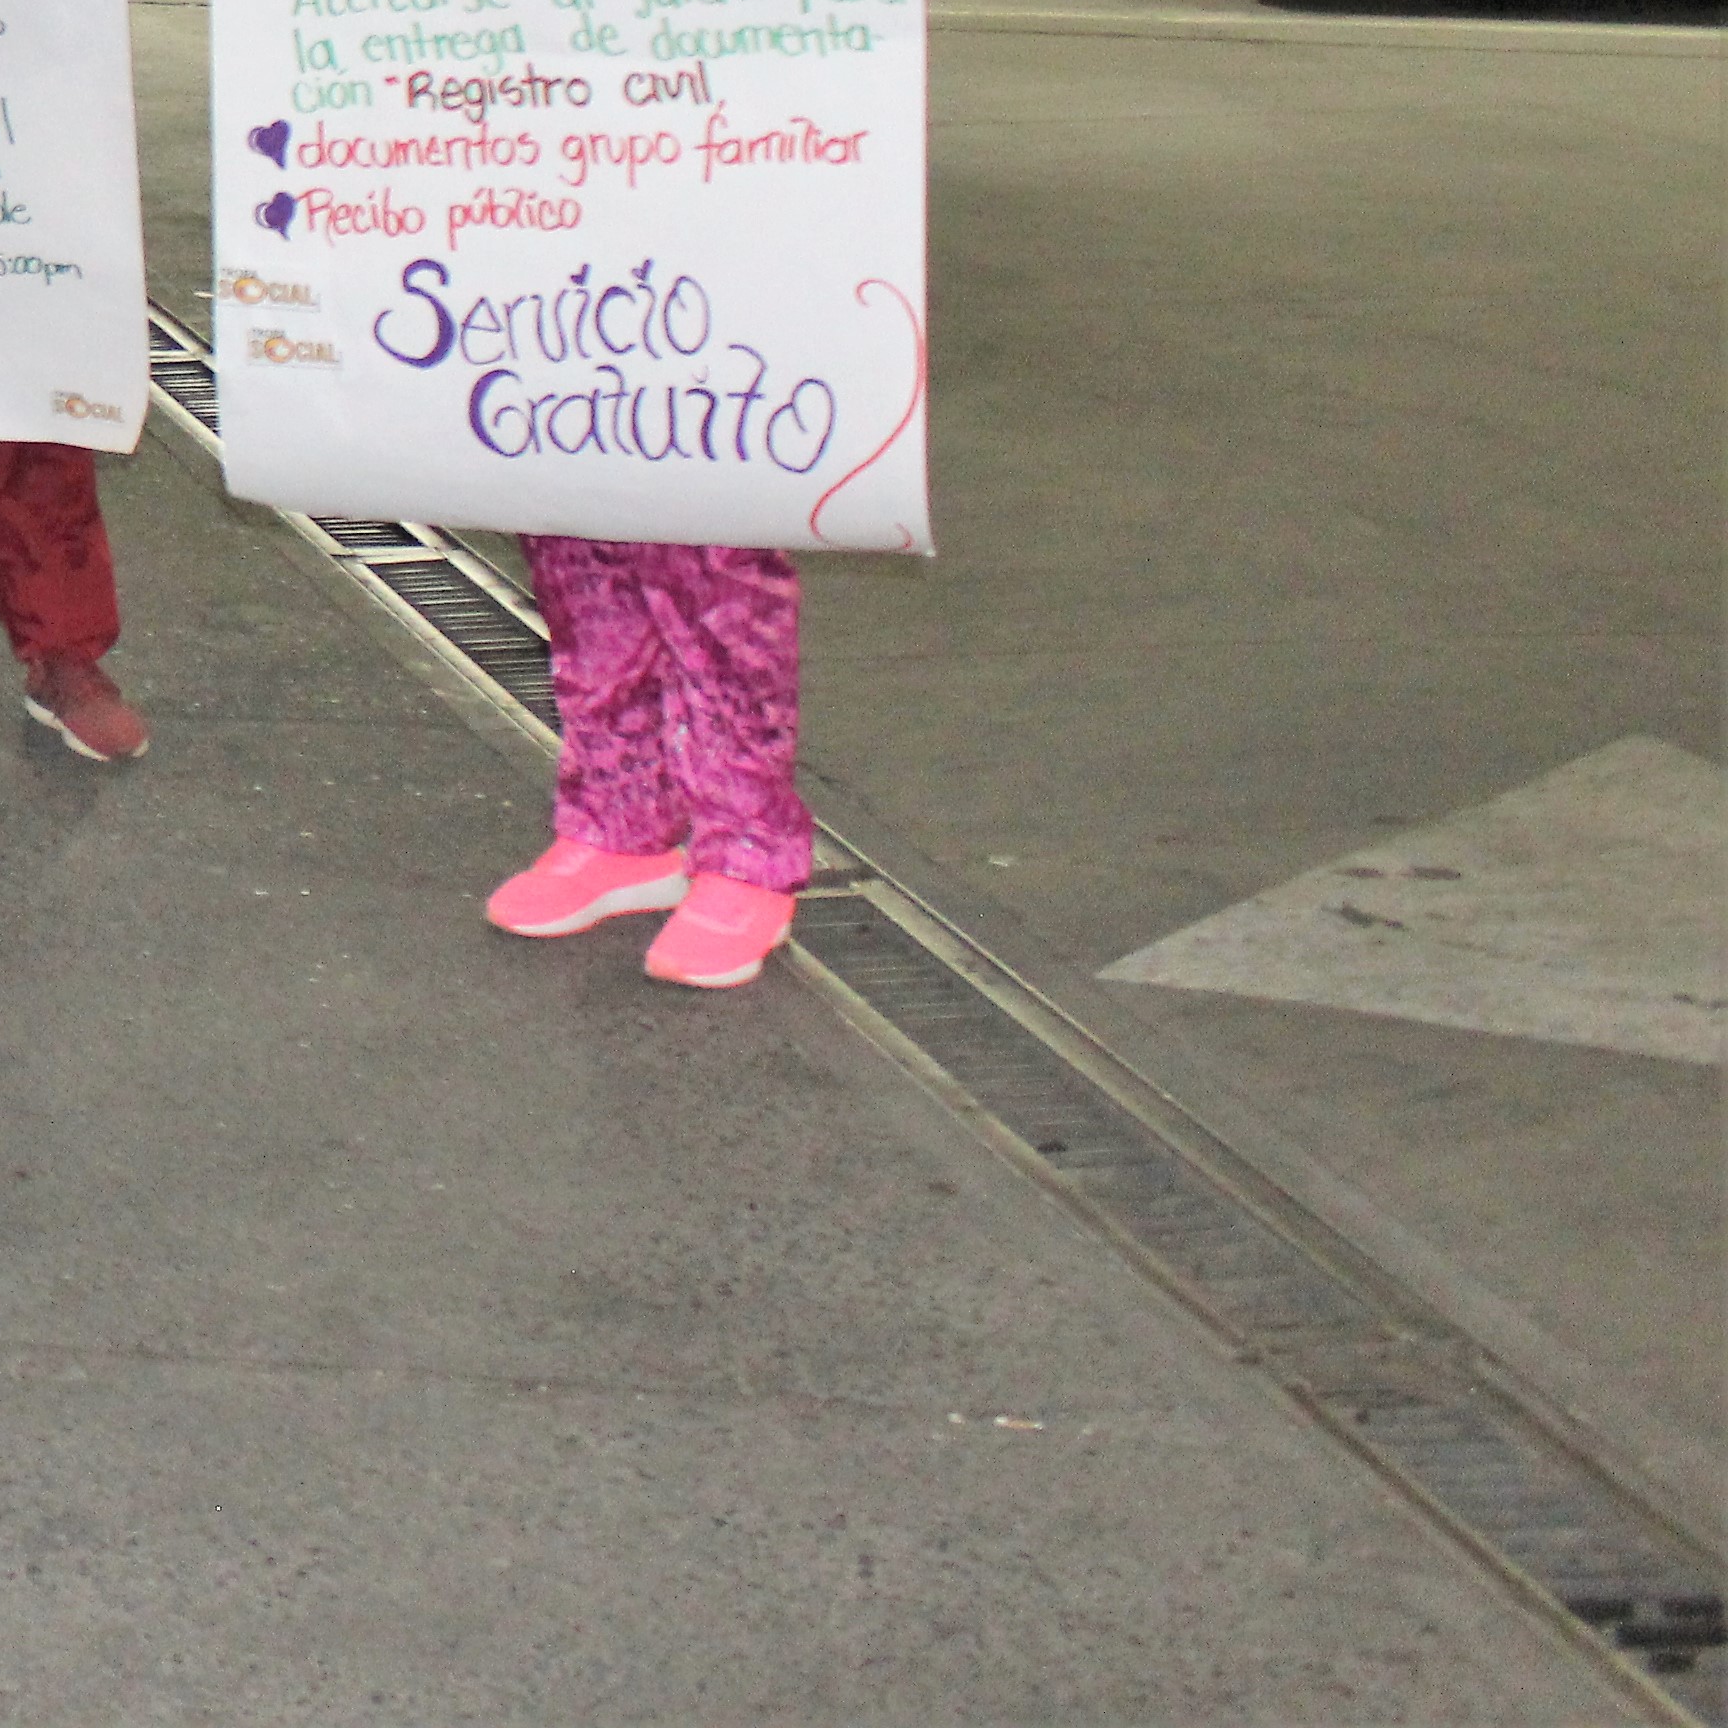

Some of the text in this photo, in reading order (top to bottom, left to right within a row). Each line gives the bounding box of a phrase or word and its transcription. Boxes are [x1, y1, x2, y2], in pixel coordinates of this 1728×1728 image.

[295, 29, 338, 74] la
[362, 23, 526, 75] entrega
[570, 13, 628, 56] de
[291, 71, 372, 113] ción
[298, 114, 870, 188] documentos grupo familiar
[295, 187, 583, 251] Recibo público
[373, 258, 710, 370] Servicio
[468, 344, 836, 474] Gratuito
